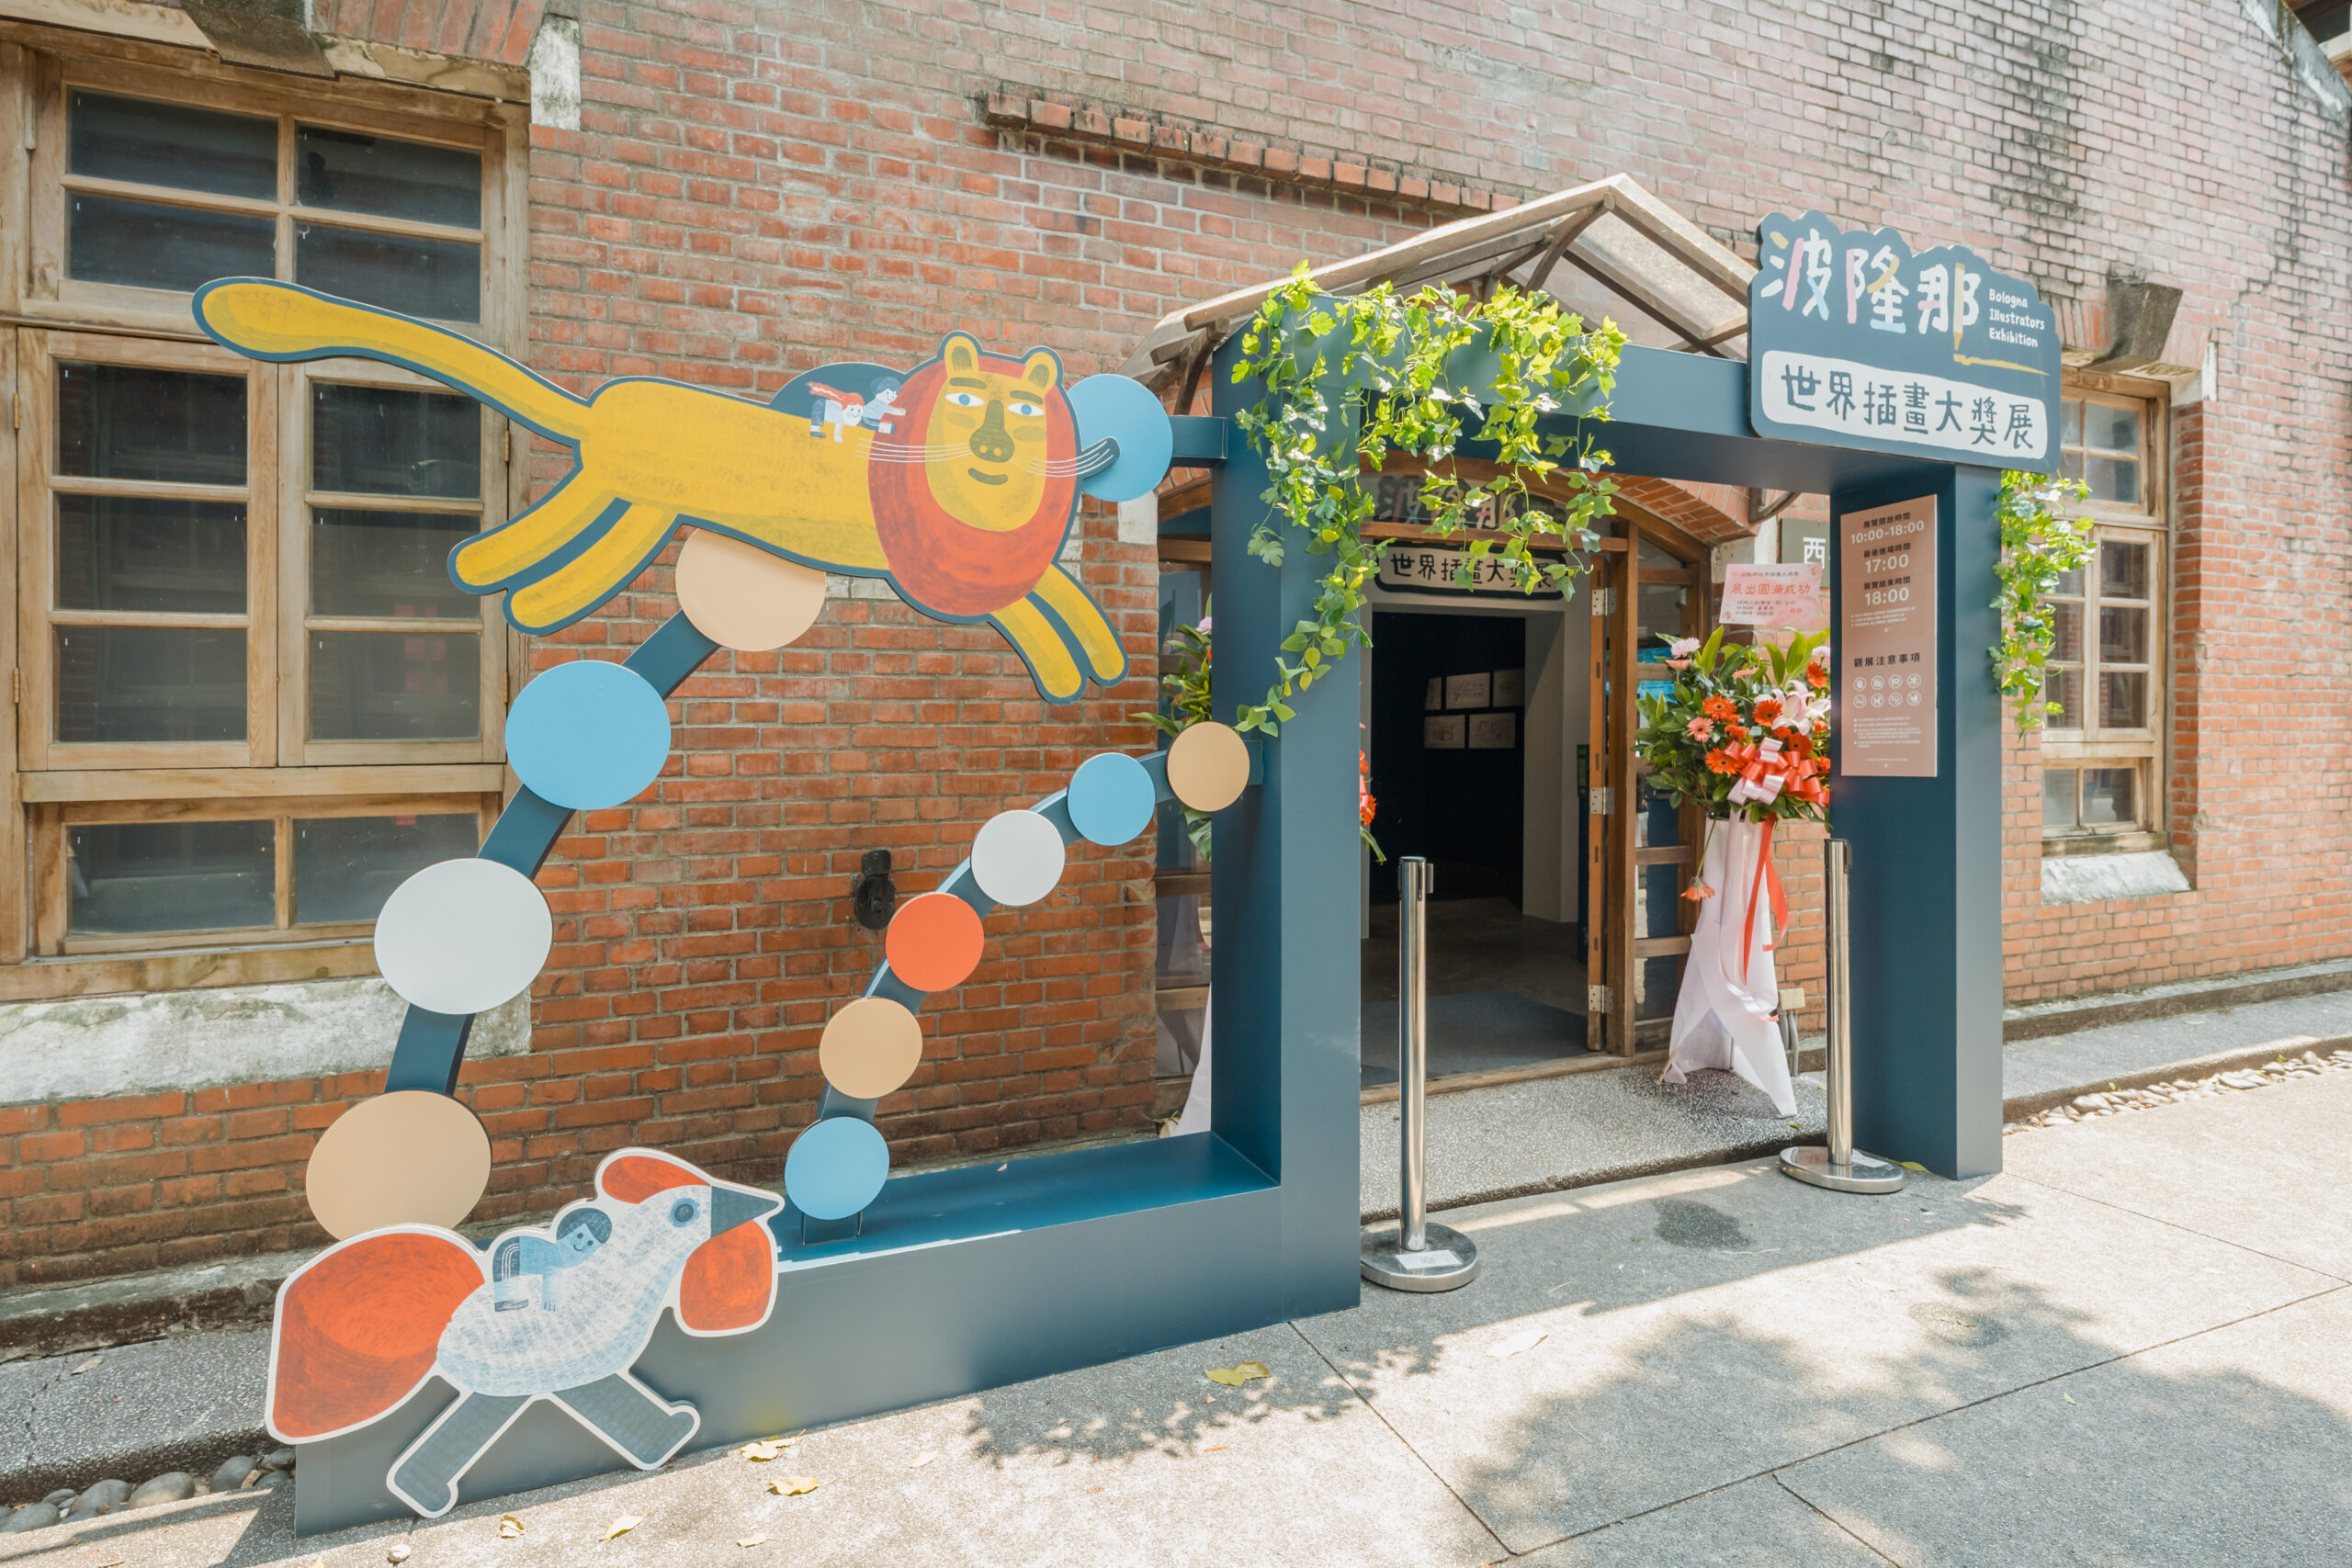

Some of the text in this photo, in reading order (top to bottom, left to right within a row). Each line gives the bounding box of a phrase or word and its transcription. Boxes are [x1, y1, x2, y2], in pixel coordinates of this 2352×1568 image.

[1760, 228, 1982, 351] 波隆那
[1989, 288, 2028, 309] Bologna
[1989, 308, 2045, 330] Illustrators
[1989, 327, 2038, 347] Exhibition
[1781, 364, 2033, 449] 世界插畫大獎展
[1850, 520, 1926, 545] 10:00-18:00
[1803, 536, 1826, 569] 西
[1865, 554, 1909, 574] 17:00
[1730, 583, 1811, 595] 展出圓滿成功
[1864, 587, 1909, 606] 18:00
